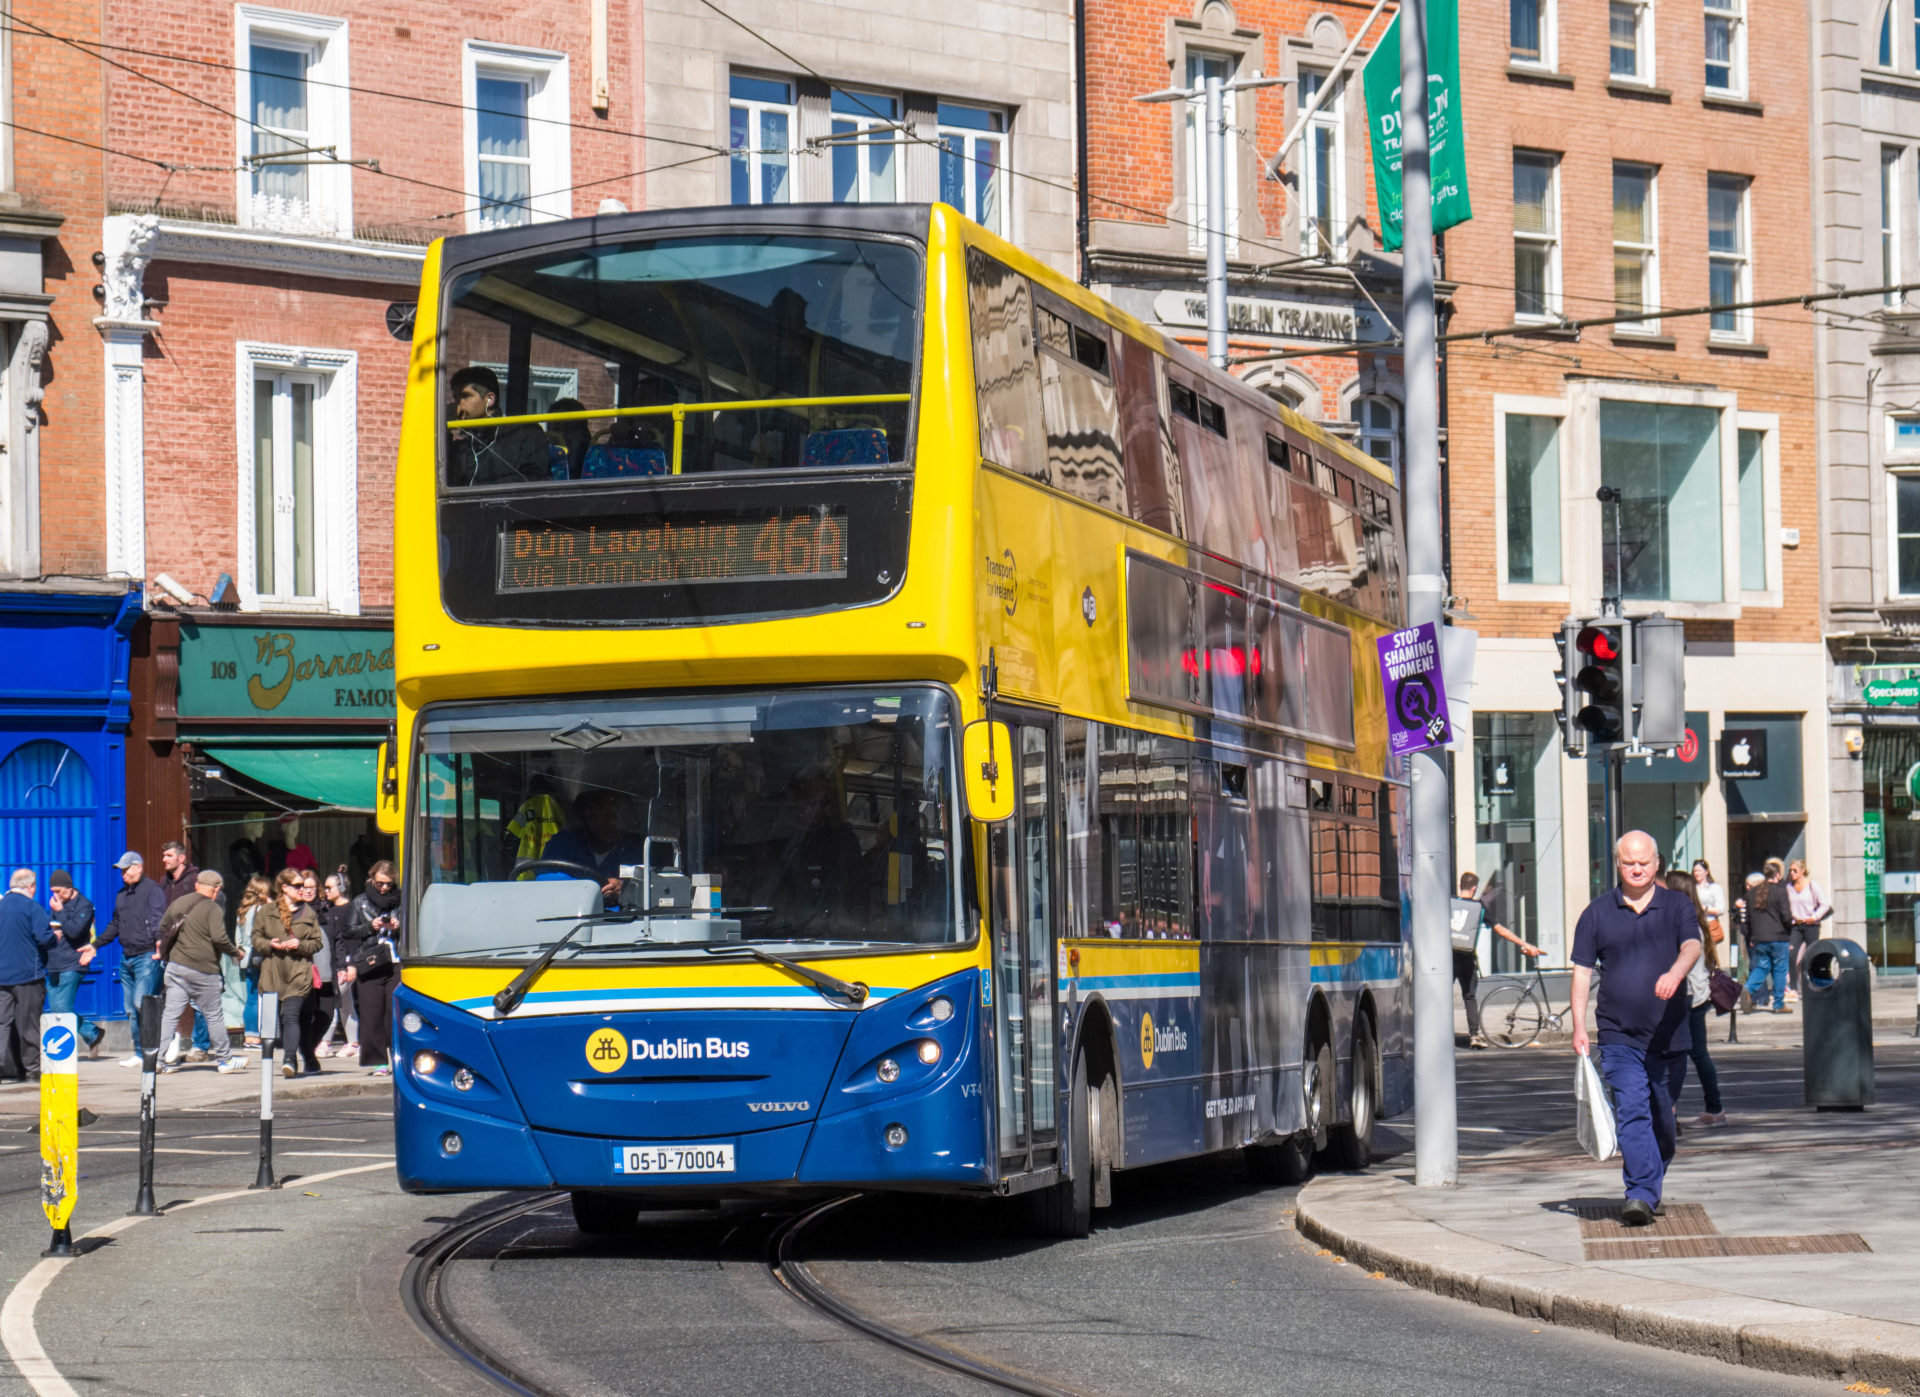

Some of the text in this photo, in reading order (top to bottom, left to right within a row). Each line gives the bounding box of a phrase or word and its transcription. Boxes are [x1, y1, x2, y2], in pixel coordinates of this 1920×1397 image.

[1227, 302, 1275, 331] UBLIN
[1278, 308, 1352, 337] TRADING
[513, 520, 738, 558] Dún Laoghaire
[753, 514, 841, 576] 46A
[513, 560, 553, 588] via
[985, 556, 1014, 579] Transport
[986, 579, 995, 597] for
[995, 583, 1014, 602] Ireland
[1393, 627, 1420, 649] STOP
[1384, 639, 1435, 667] SHAMING
[210, 661, 237, 680] 108
[1388, 655, 1435, 681] WOMEN!
[1868, 686, 1919, 700] Specsavers
[1425, 716, 1446, 741] YES
[631, 1037, 749, 1060] Dublin Bus
[1154, 1026, 1187, 1052] Dublin Bus
[746, 1101, 811, 1113] VOLVO
[1206, 1100, 1216, 1119] GET
[1217, 1098, 1227, 1117] THE
[630, 1151, 725, 1171] 05-D-70004
